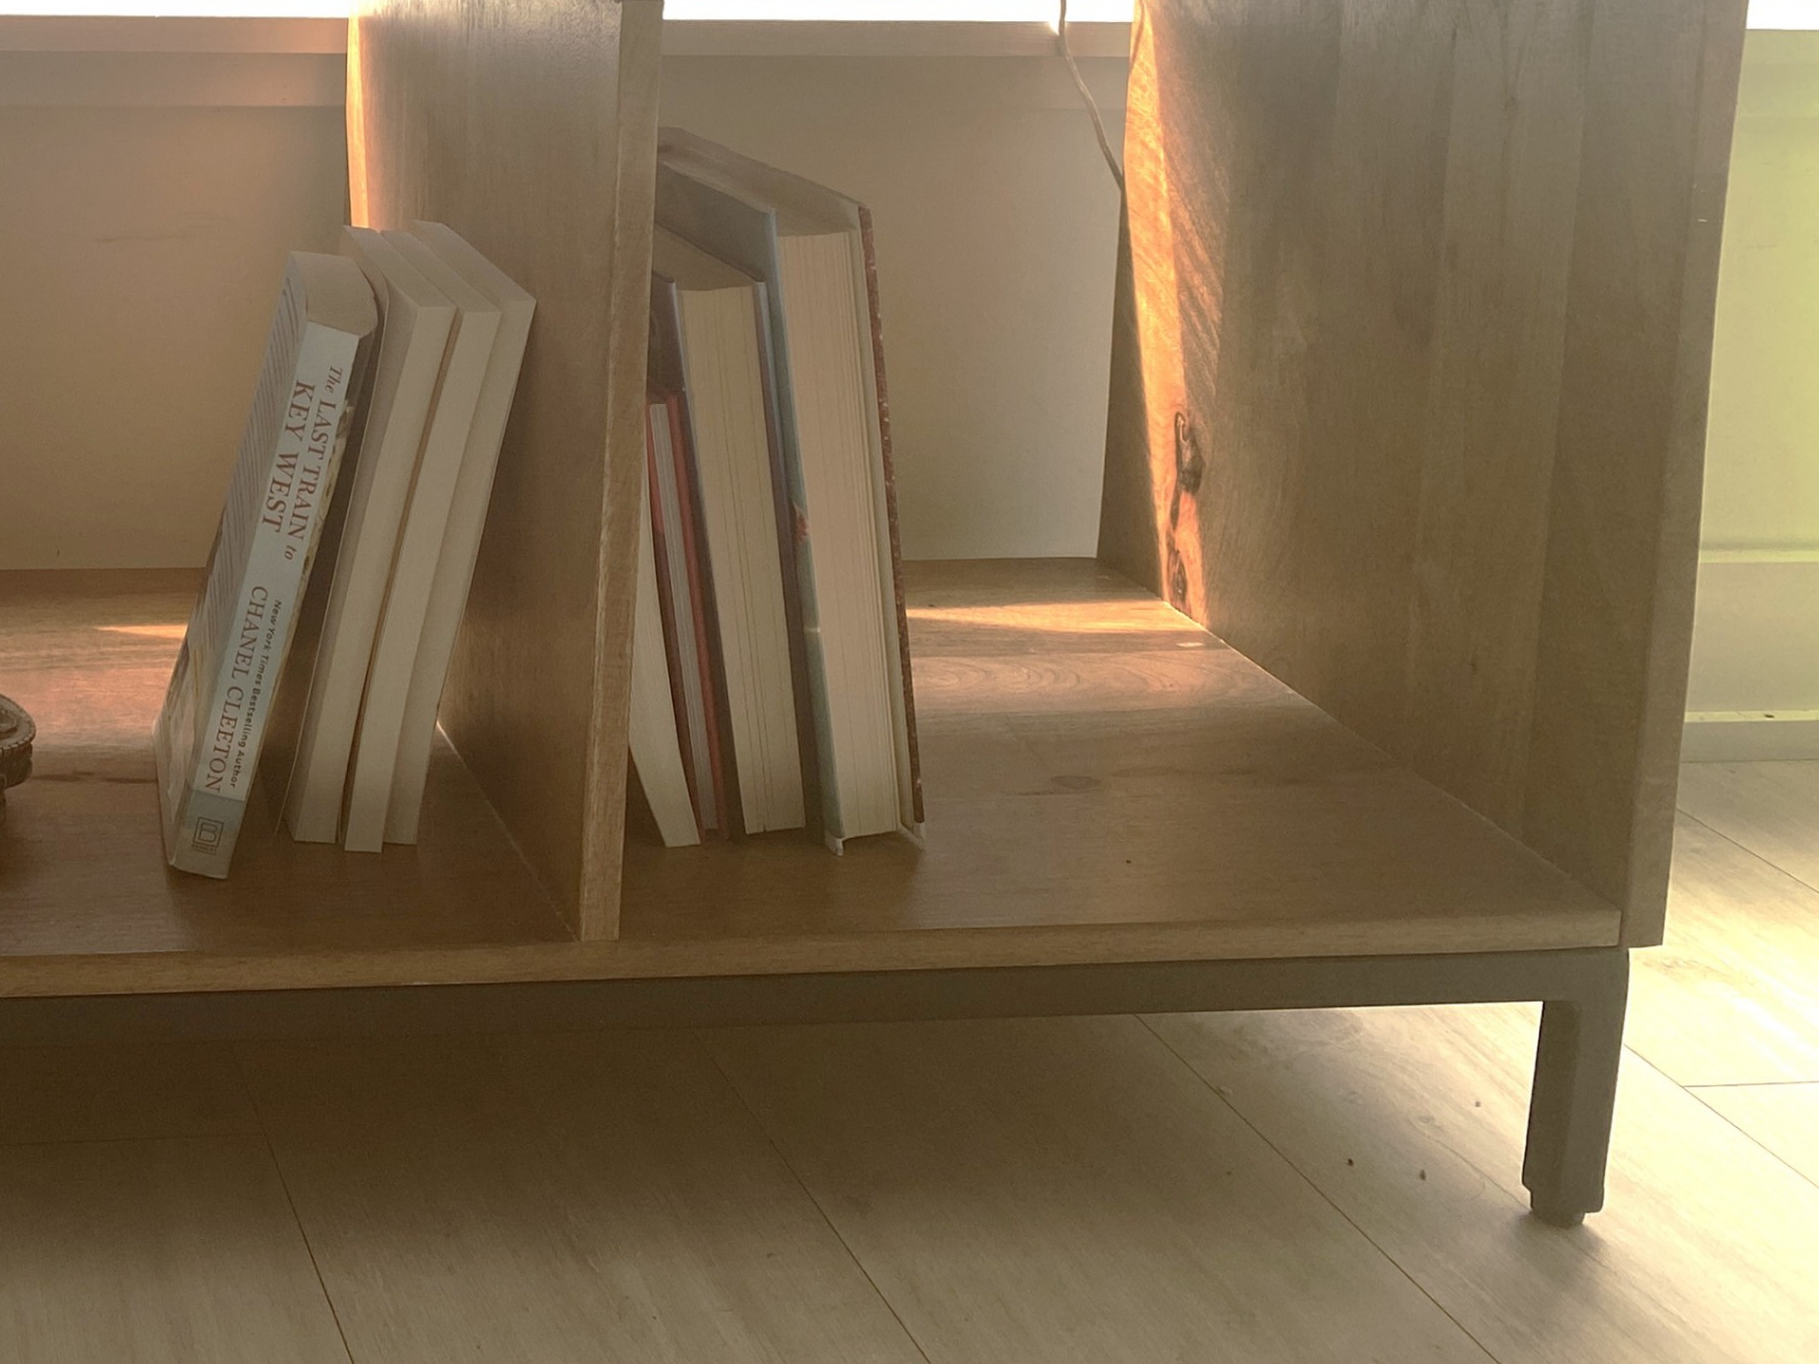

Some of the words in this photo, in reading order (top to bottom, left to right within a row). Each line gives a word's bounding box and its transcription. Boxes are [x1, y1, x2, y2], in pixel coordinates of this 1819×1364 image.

[325, 364, 343, 394] The
[284, 379, 316, 442] KEY
[307, 399, 337, 461] LAST
[262, 451, 300, 533] WEST
[287, 464, 321, 540] TRAIN
[284, 544, 297, 561] to
[232, 586, 269, 679] CHANEL
[263, 627, 276, 652] York
[270, 599, 283, 626] New
[255, 655, 270, 686] Times
[204, 686, 244, 794] CLEETON
[237, 687, 261, 748] Bestselling
[229, 749, 246, 789] Author
